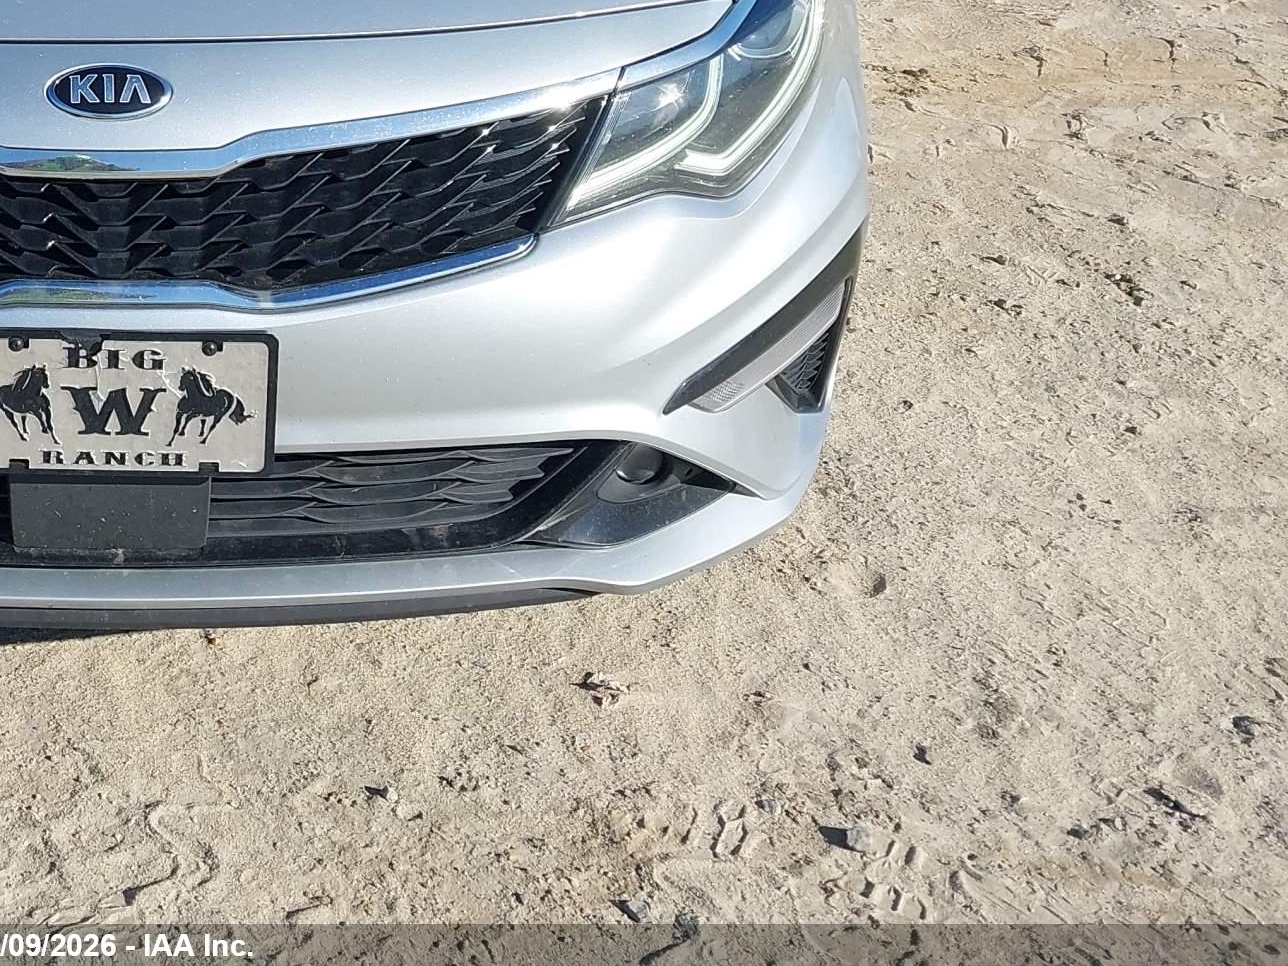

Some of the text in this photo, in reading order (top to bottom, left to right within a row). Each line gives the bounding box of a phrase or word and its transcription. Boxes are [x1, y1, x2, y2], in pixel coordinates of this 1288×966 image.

[69, 73, 151, 104] KIA
[63, 347, 165, 370] BIG
[61, 386, 166, 436] W
[40, 450, 187, 467] RANCH
